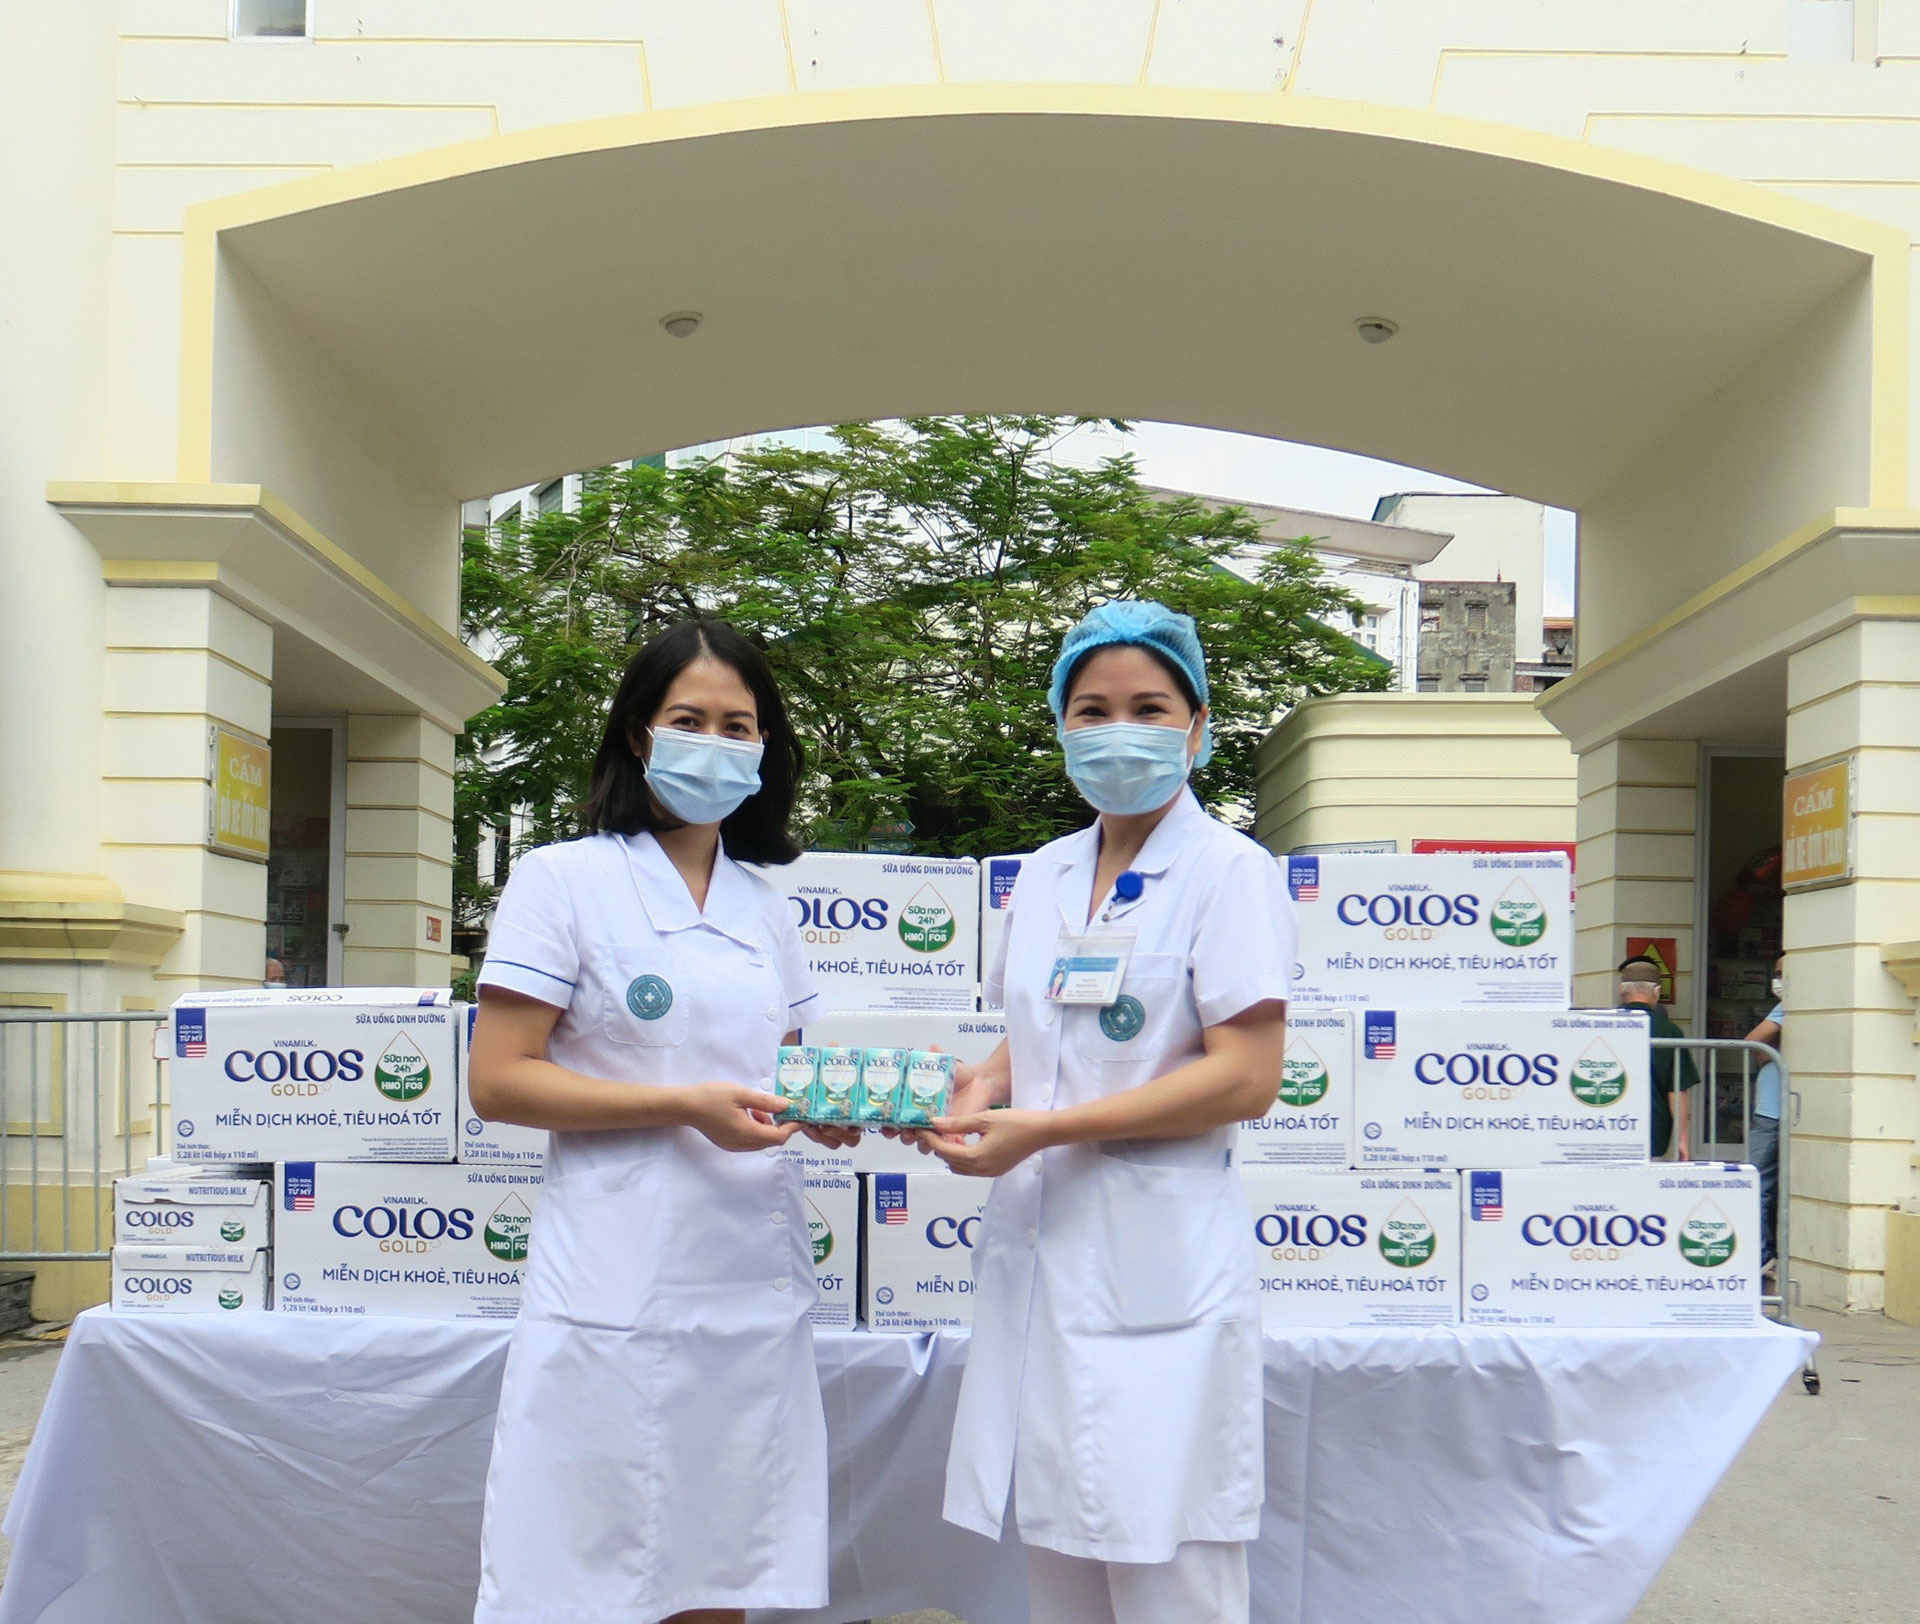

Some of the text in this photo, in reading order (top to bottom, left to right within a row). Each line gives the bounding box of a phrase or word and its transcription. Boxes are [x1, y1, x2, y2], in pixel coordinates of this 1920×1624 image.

[882, 863, 974, 875] SỮA UỐNG DINH DƯỠNG
[788, 896, 888, 931] OLOS
[908, 906, 946, 915] Sữa non
[1338, 894, 1480, 926] COLOS
[918, 916, 934, 925] 24h
[802, 931, 841, 944] OLD
[904, 932, 947, 942] HMO FOS
[1384, 928, 1432, 940] GOLD
[866, 959, 898, 974] TIÊU
[902, 960, 933, 975] HOÁ
[936, 960, 965, 976] TỐT
[1327, 952, 1364, 969] MIỄN
[1368, 958, 1405, 971] DỊCH
[1458, 954, 1490, 969] TIÊU
[1494, 954, 1526, 969] HOÁ
[1528, 952, 1558, 969] TỐT
[356, 1013, 446, 1024] SỮA UỐNG DINH DƯỠNG
[1295, 1019, 1314, 1027] DINH
[958, 1022, 974, 1033] SỮA
[976, 1022, 998, 1033] UỐNG
[384, 1054, 401, 1062] Sữa
[780, 1056, 814, 1066] COLOS
[224, 1049, 364, 1082] COLOS
[394, 1064, 412, 1073] 24h
[912, 1060, 947, 1072] COLOS
[1414, 1053, 1558, 1086] COLOS
[271, 1084, 318, 1096] GOLD
[381, 1082, 423, 1090] HMO FOS
[1463, 1087, 1511, 1100] GOLD
[216, 1108, 252, 1126] MIỄN
[256, 1114, 292, 1128] DỊCH
[344, 1110, 376, 1125] TIÊU
[378, 1110, 410, 1125] HOÁ
[412, 1108, 442, 1125] TỐT
[1274, 1113, 1339, 1130] HOÁ TỐT
[1404, 1111, 1442, 1129] MIỄN
[1446, 1117, 1484, 1132] DỊCH
[1537, 1115, 1570, 1130] TIÊU
[1573, 1115, 1606, 1130] HOÁ
[1608, 1114, 1638, 1130] TỐT
[467, 1173, 483, 1183] SỮA
[485, 1172, 507, 1184] UỐNG
[509, 1175, 528, 1184] DINH
[823, 1178, 851, 1189] DƯỠNG
[189, 1187, 247, 1195] NUTRITIOUS MILK
[126, 1211, 194, 1227] COLOS
[333, 1206, 474, 1240] COLOS
[494, 1214, 511, 1222] Sữa
[504, 1225, 521, 1233] 24h
[1255, 1214, 1367, 1247] OLOS
[1522, 1214, 1666, 1246] COLOS
[379, 1240, 426, 1253] GOLD
[490, 1241, 527, 1250] HMO FO
[186, 1254, 244, 1262] NUTRITIOUS MILK
[1272, 1248, 1319, 1260] GOLD
[1570, 1248, 1619, 1260] GOLD
[322, 1263, 359, 1281] MIỄN
[364, 1270, 400, 1284] DỊCH
[453, 1269, 484, 1284] TIÊU
[488, 1270, 521, 1285] HOÁ
[124, 1277, 192, 1294] COLOS
[916, 1275, 954, 1292] MIỄN
[1346, 1276, 1378, 1291] TIÊU
[1381, 1277, 1415, 1292] HOÁ
[1417, 1275, 1446, 1292] TỐT
[1511, 1272, 1549, 1290] MIỄN
[1554, 1278, 1591, 1292] DỊCH
[1645, 1276, 1679, 1291] TIÊU
[1681, 1276, 1714, 1291] HOÁ
[1717, 1274, 1747, 1291] TỐT
